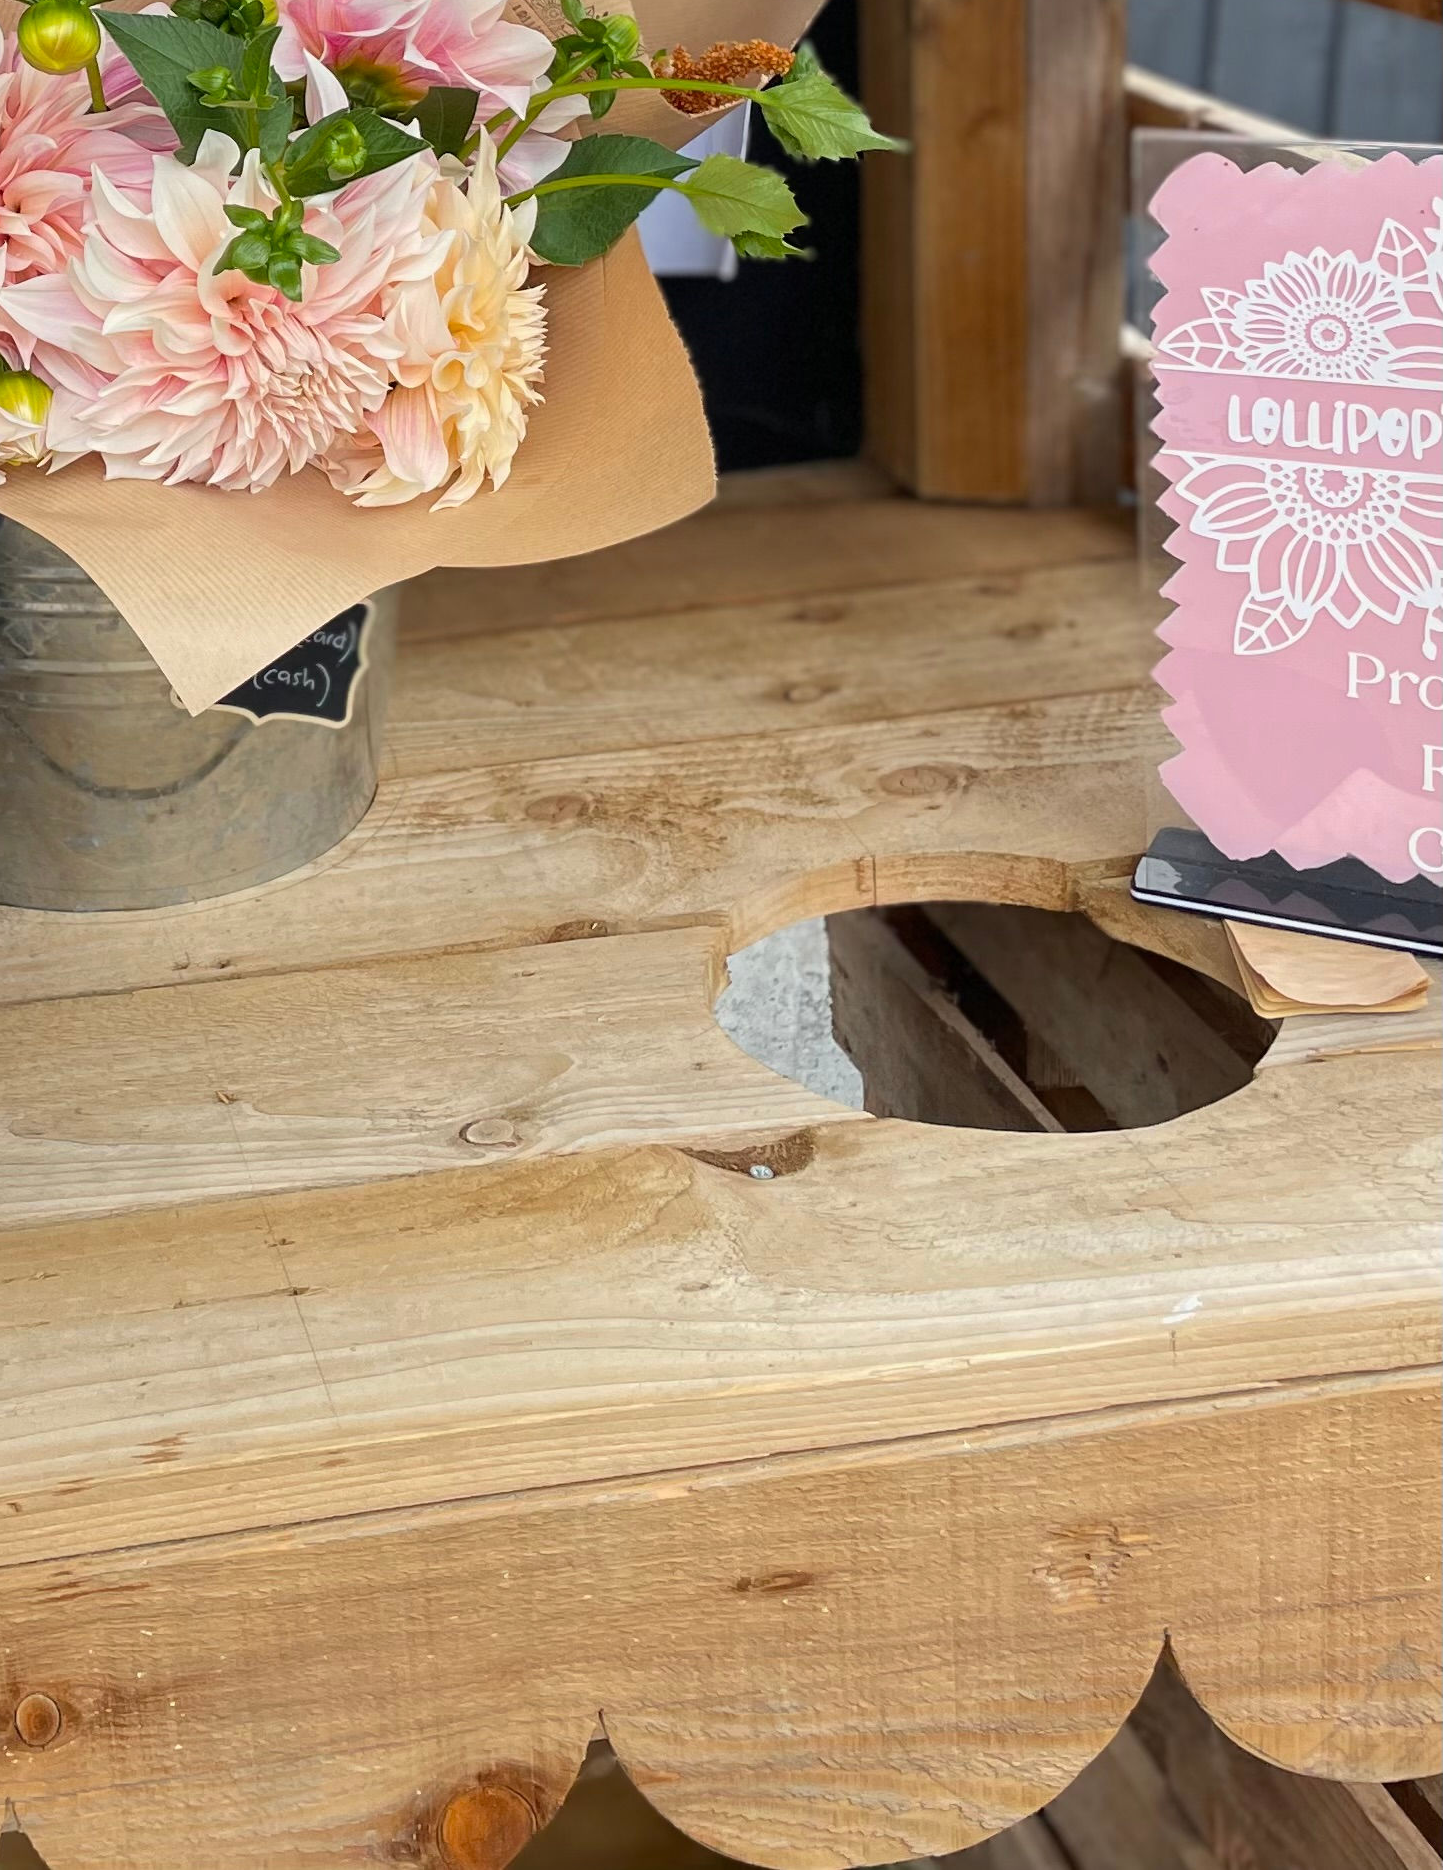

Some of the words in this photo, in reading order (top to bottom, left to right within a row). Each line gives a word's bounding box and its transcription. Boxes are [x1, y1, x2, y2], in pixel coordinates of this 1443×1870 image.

[1228, 394, 1443, 461] LOLLIPOP
[297, 620, 357, 664] ard)
[252, 663, 331, 708] (cash)
